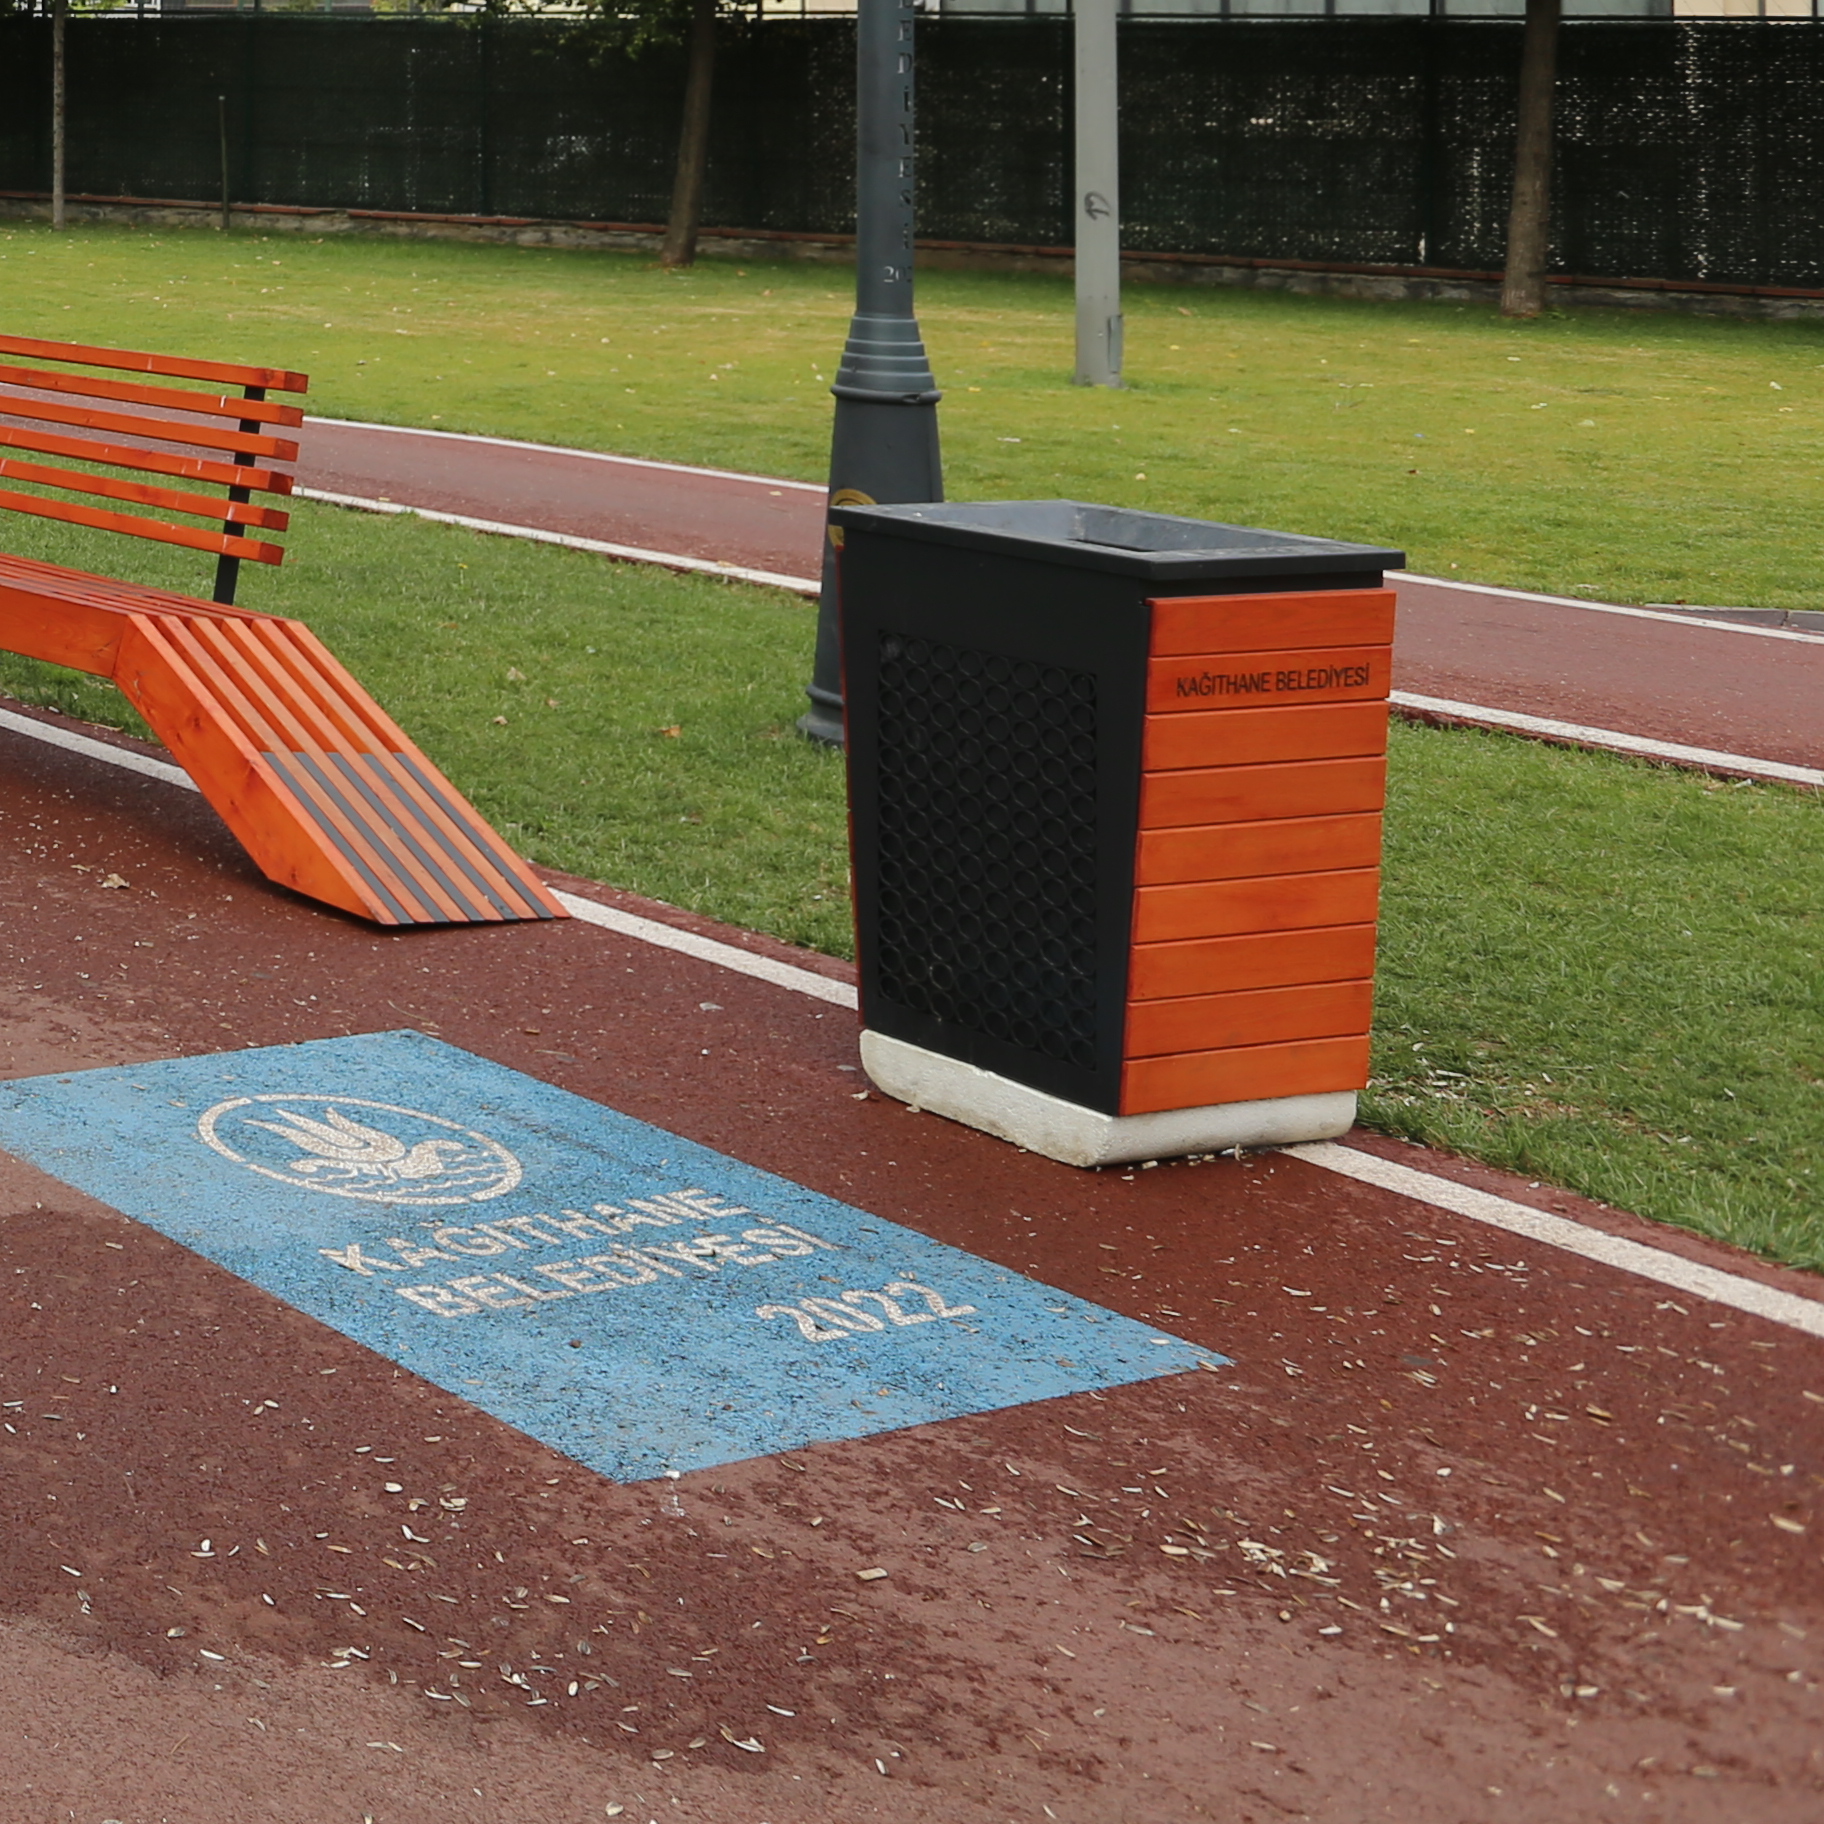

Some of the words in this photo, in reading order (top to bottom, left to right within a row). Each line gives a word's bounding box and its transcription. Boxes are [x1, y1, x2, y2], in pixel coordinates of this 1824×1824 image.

[1176, 671, 1272, 697] KAĞITHANE
[1275, 662, 1370, 692] BELEDİYESİ
[318, 1188, 750, 1276] KAĞITHANE
[394, 1217, 852, 1318] BELEDİYESİ
[755, 1280, 978, 1344] 2022
